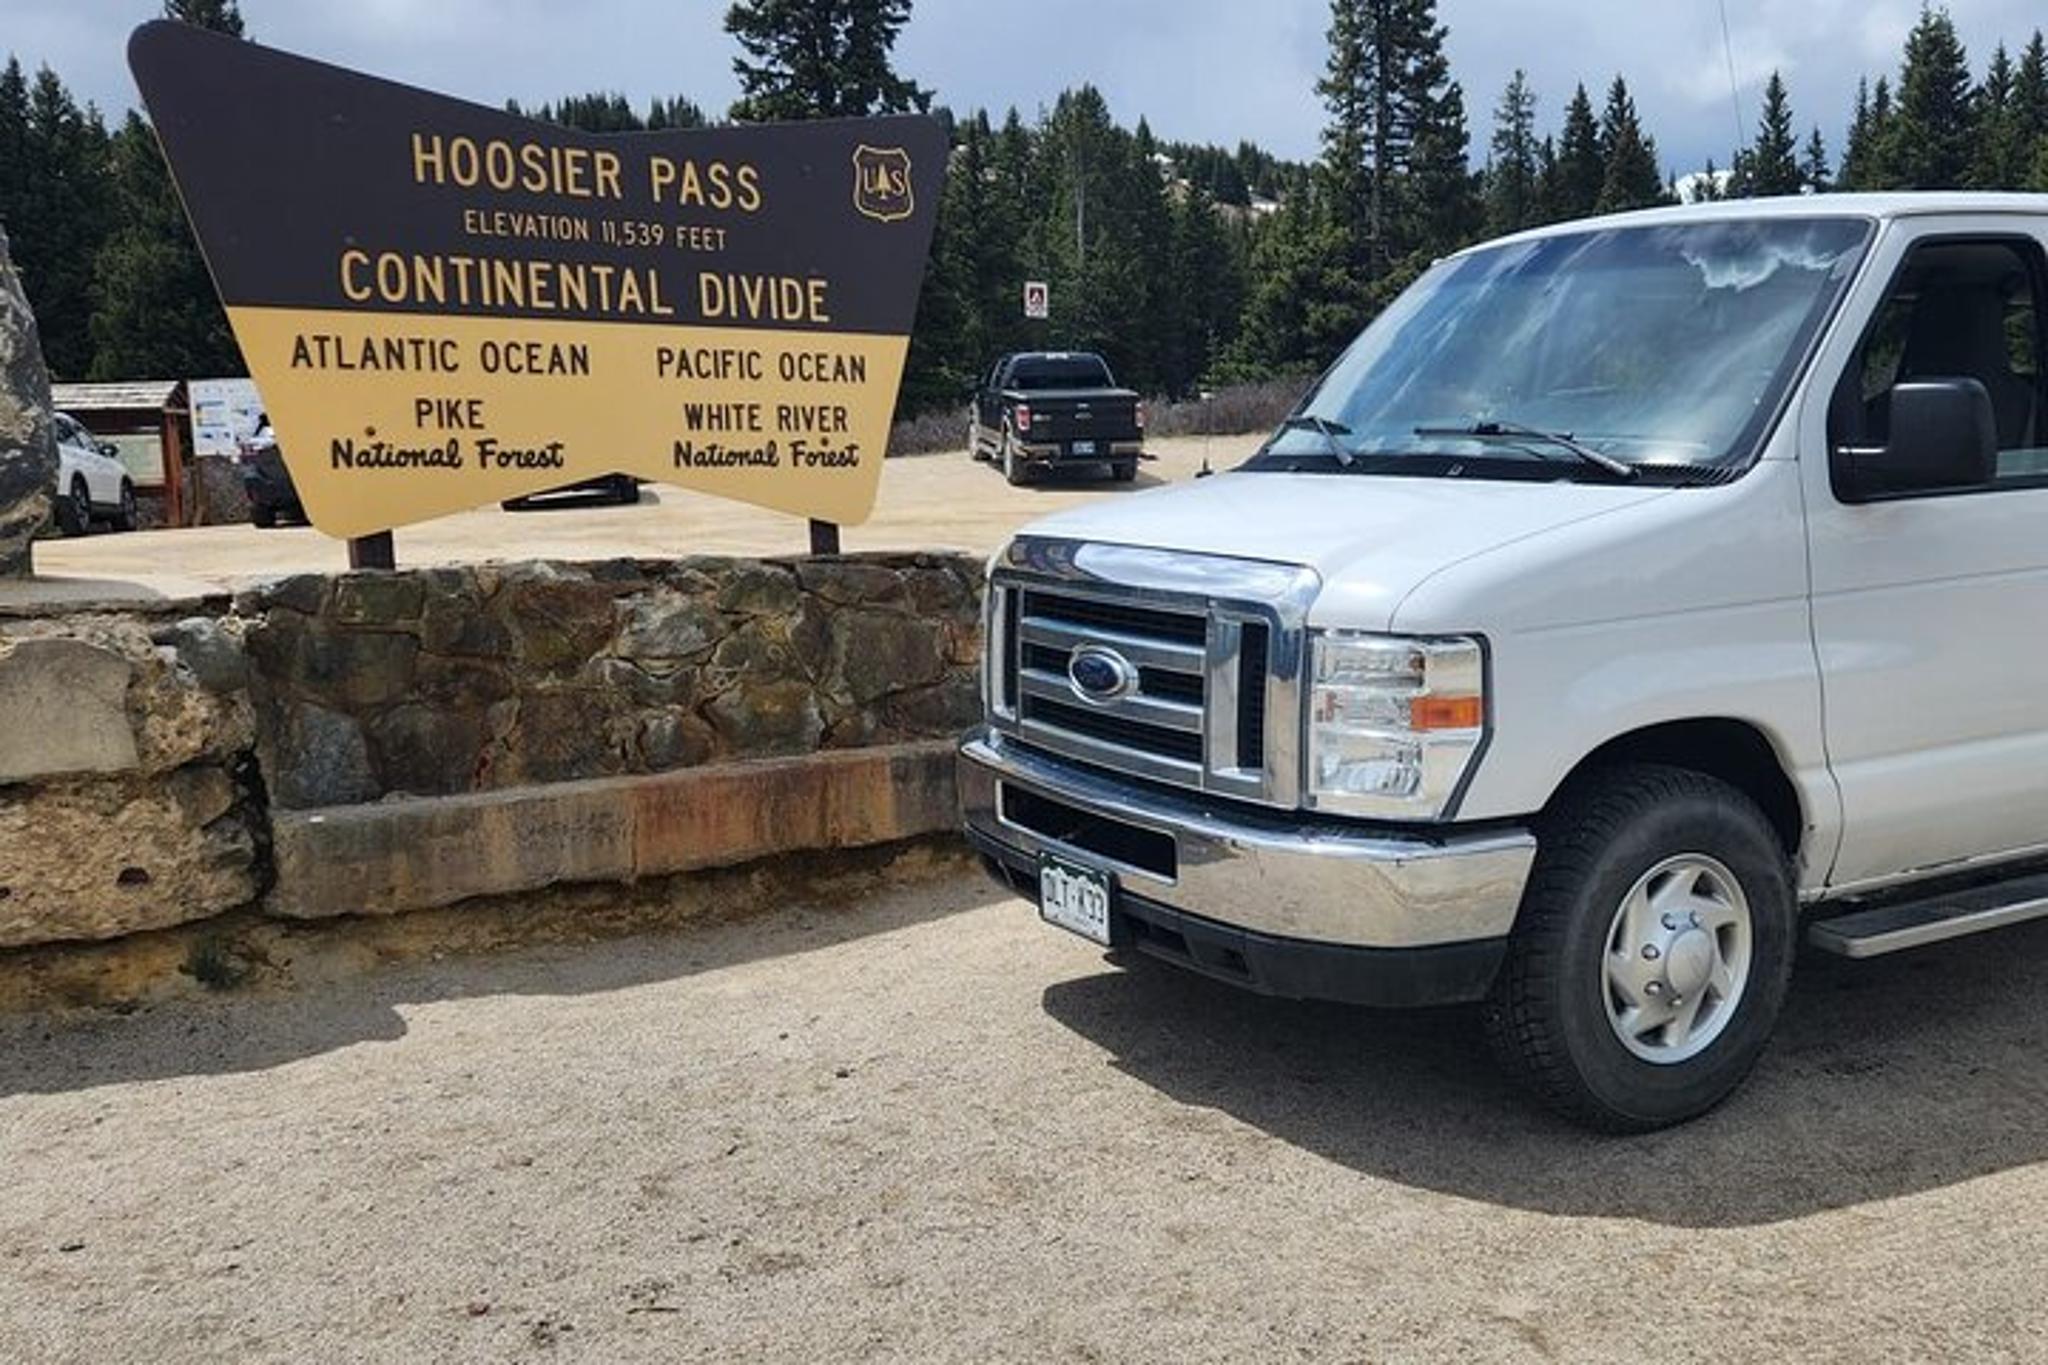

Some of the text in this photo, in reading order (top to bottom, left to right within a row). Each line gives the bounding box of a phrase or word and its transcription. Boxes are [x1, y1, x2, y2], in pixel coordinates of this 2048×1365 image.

[411, 133, 762, 211] HOOSIER PASS
[464, 208, 727, 251] ELEVATION 11,539 FEET
[340, 249, 830, 322] CONTINENTAL DIVIDE
[291, 334, 591, 376] ATLANTIC OCEAN
[656, 346, 867, 383] PACIFIC OCEAN
[415, 397, 485, 430] PIKE
[684, 402, 849, 433] WHITE RIVER
[330, 438, 566, 469] National Forest
[673, 438, 861, 469] National Forest
